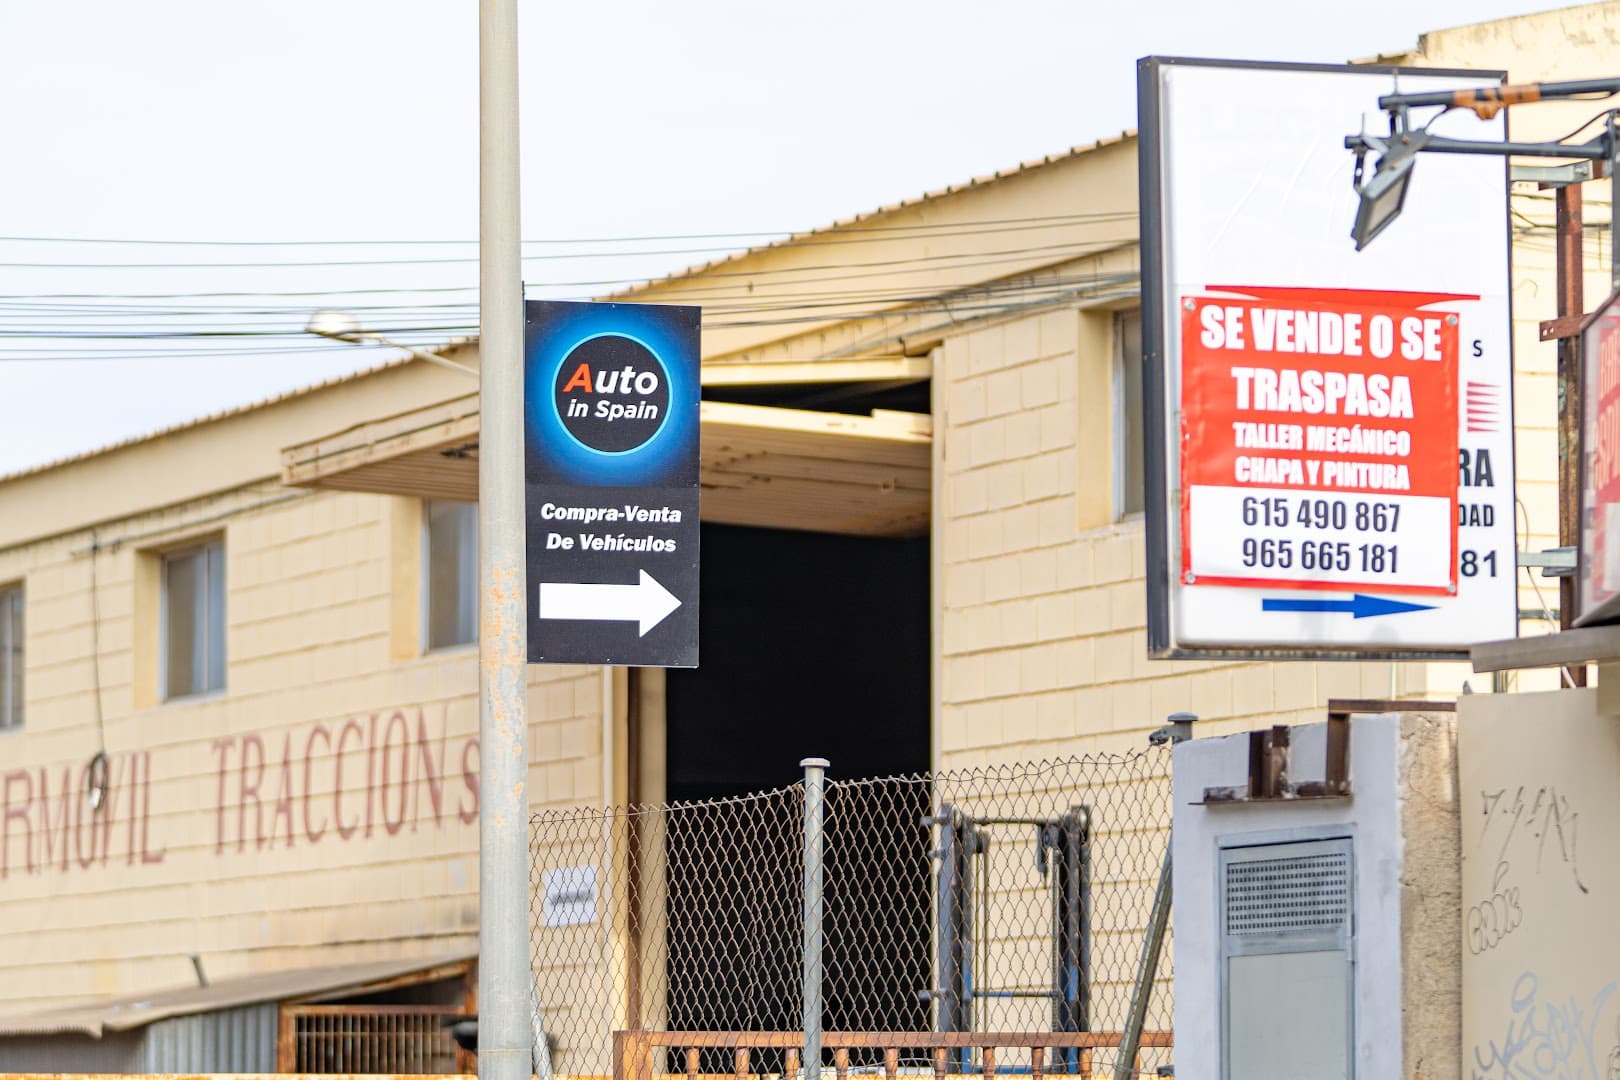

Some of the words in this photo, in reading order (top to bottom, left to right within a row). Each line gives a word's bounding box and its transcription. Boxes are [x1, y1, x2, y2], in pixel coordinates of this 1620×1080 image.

[1200, 305, 1245, 350] SE
[1251, 308, 1363, 356] VENDE
[1369, 314, 1394, 359] O
[1400, 316, 1442, 361] SE
[562, 362, 659, 395] Auto
[1231, 366, 1414, 418] TRASPASA
[567, 399, 589, 418] in
[595, 399, 659, 422] Spain
[1232, 421, 1304, 451] TALLER
[1306, 424, 1411, 457] MECÁNICO
[1235, 456, 1305, 485] CHAPA
[1305, 459, 1321, 486] Y
[1322, 460, 1411, 490] PINTURA
[540, 502, 682, 524] Compra-Venta
[1242, 496, 1289, 528] 615
[1297, 498, 1347, 530] 490
[1355, 501, 1401, 533] 867
[546, 532, 575, 550] De
[578, 532, 677, 552] Vehículos
[1242, 537, 1293, 569] 965
[1301, 540, 1351, 571] 665
[1358, 543, 1398, 574] 181
[1460, 549, 1498, 578] 81
